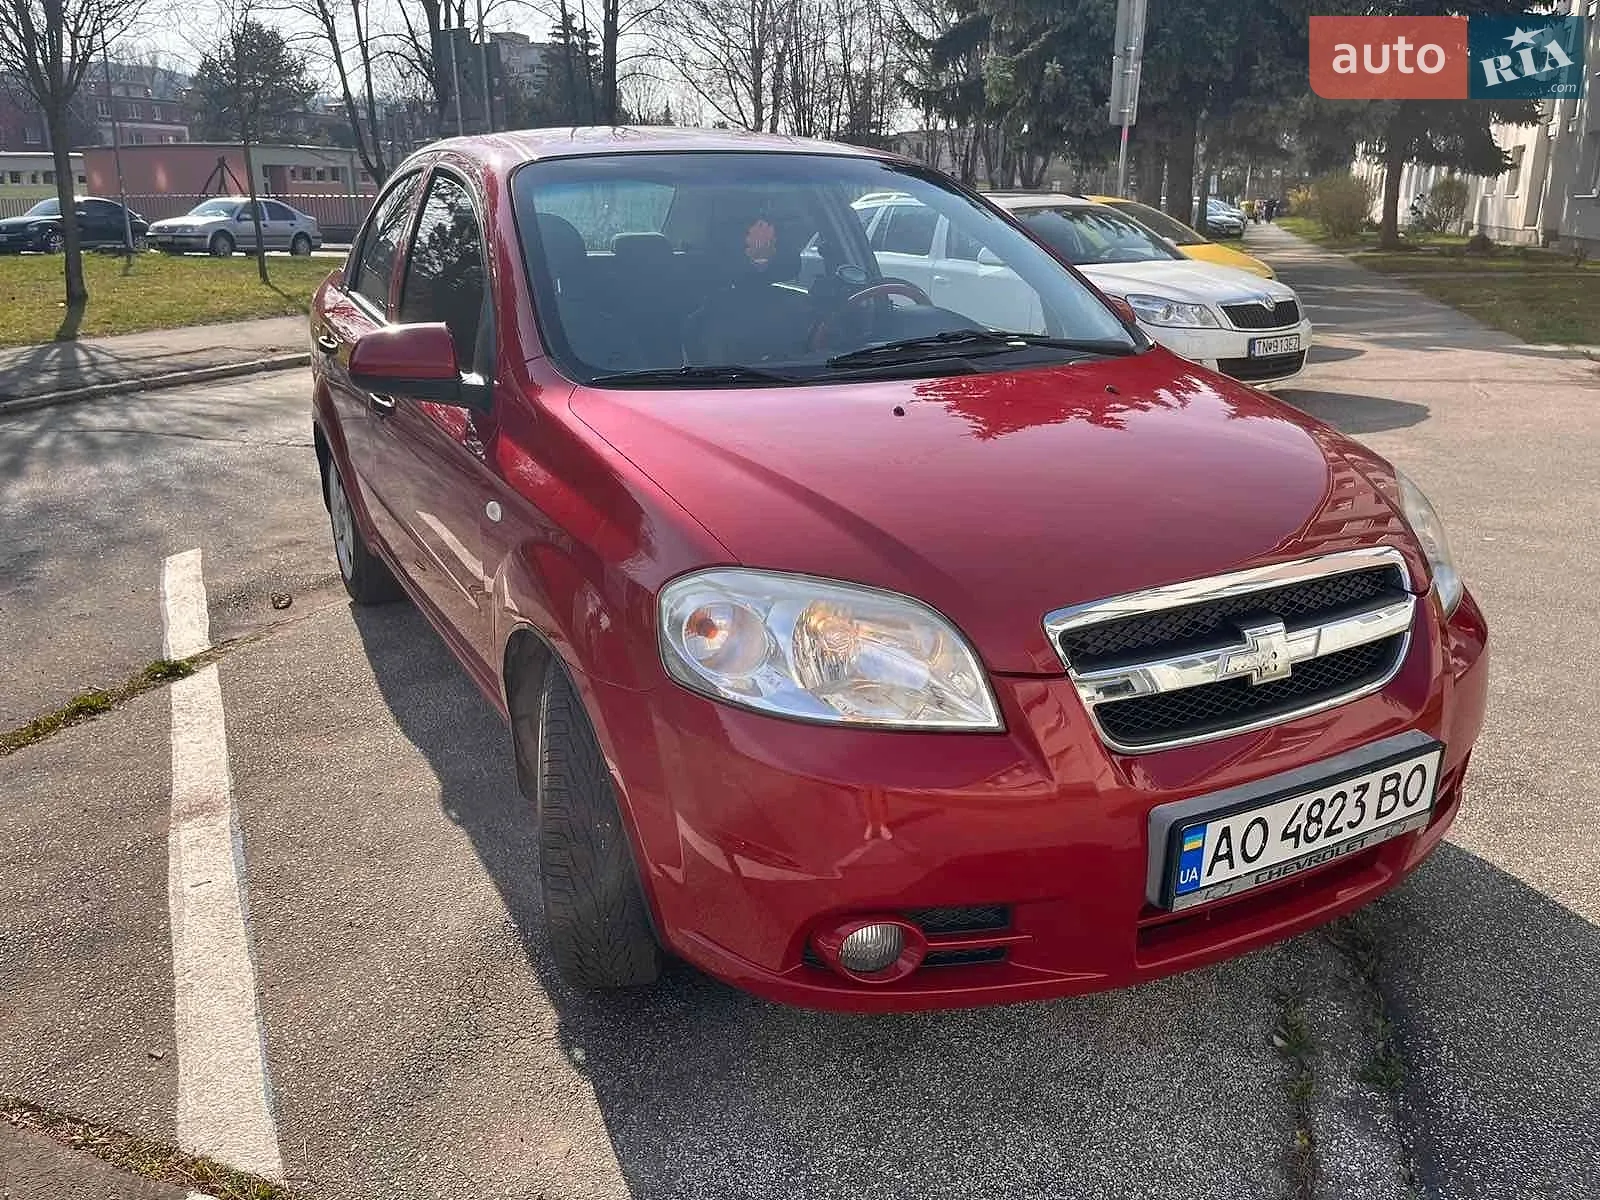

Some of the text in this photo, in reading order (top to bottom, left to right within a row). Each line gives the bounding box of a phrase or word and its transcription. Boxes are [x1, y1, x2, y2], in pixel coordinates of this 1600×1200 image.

[1206, 763, 1427, 877] AO 4823 BO
[1180, 869, 1198, 884] UA
[1254, 837, 1368, 885] CHEVROLET
